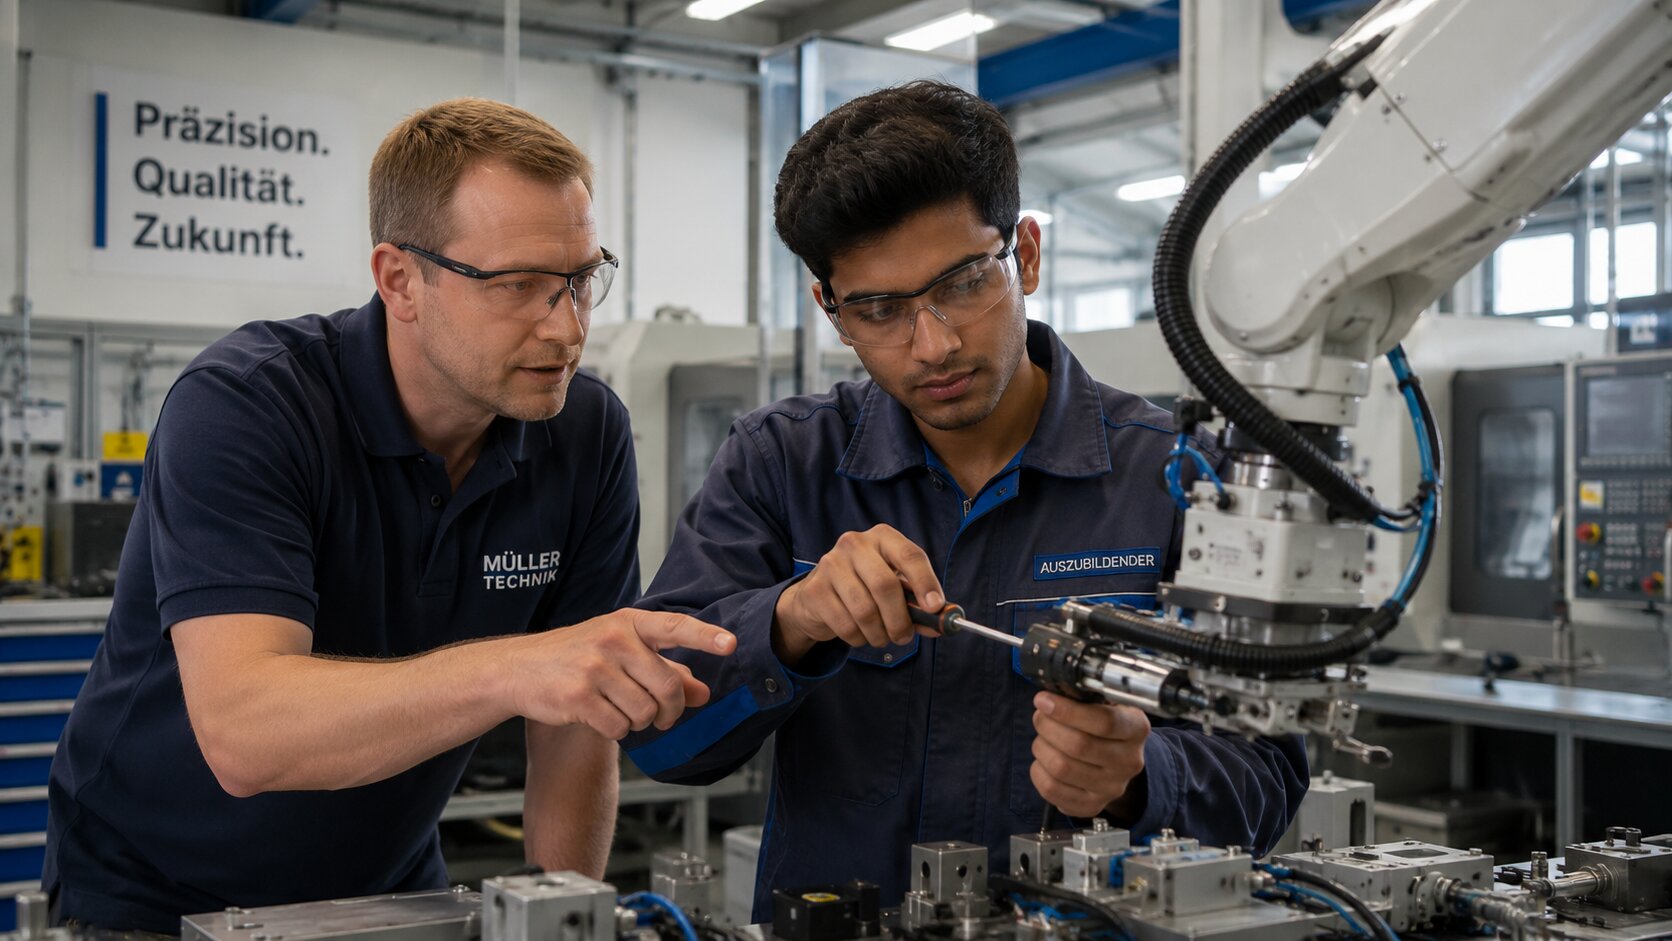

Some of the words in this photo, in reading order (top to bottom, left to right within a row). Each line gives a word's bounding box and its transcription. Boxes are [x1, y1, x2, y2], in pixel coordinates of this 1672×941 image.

[134, 101, 330, 156] Präzision.
[133, 157, 304, 206] Qualität.
[133, 212, 304, 258] Zukunft.
[483, 551, 560, 572] MÜLLER
[1040, 554, 1155, 574] AUSZUBILDENDER
[483, 569, 558, 589] TECHNIK
